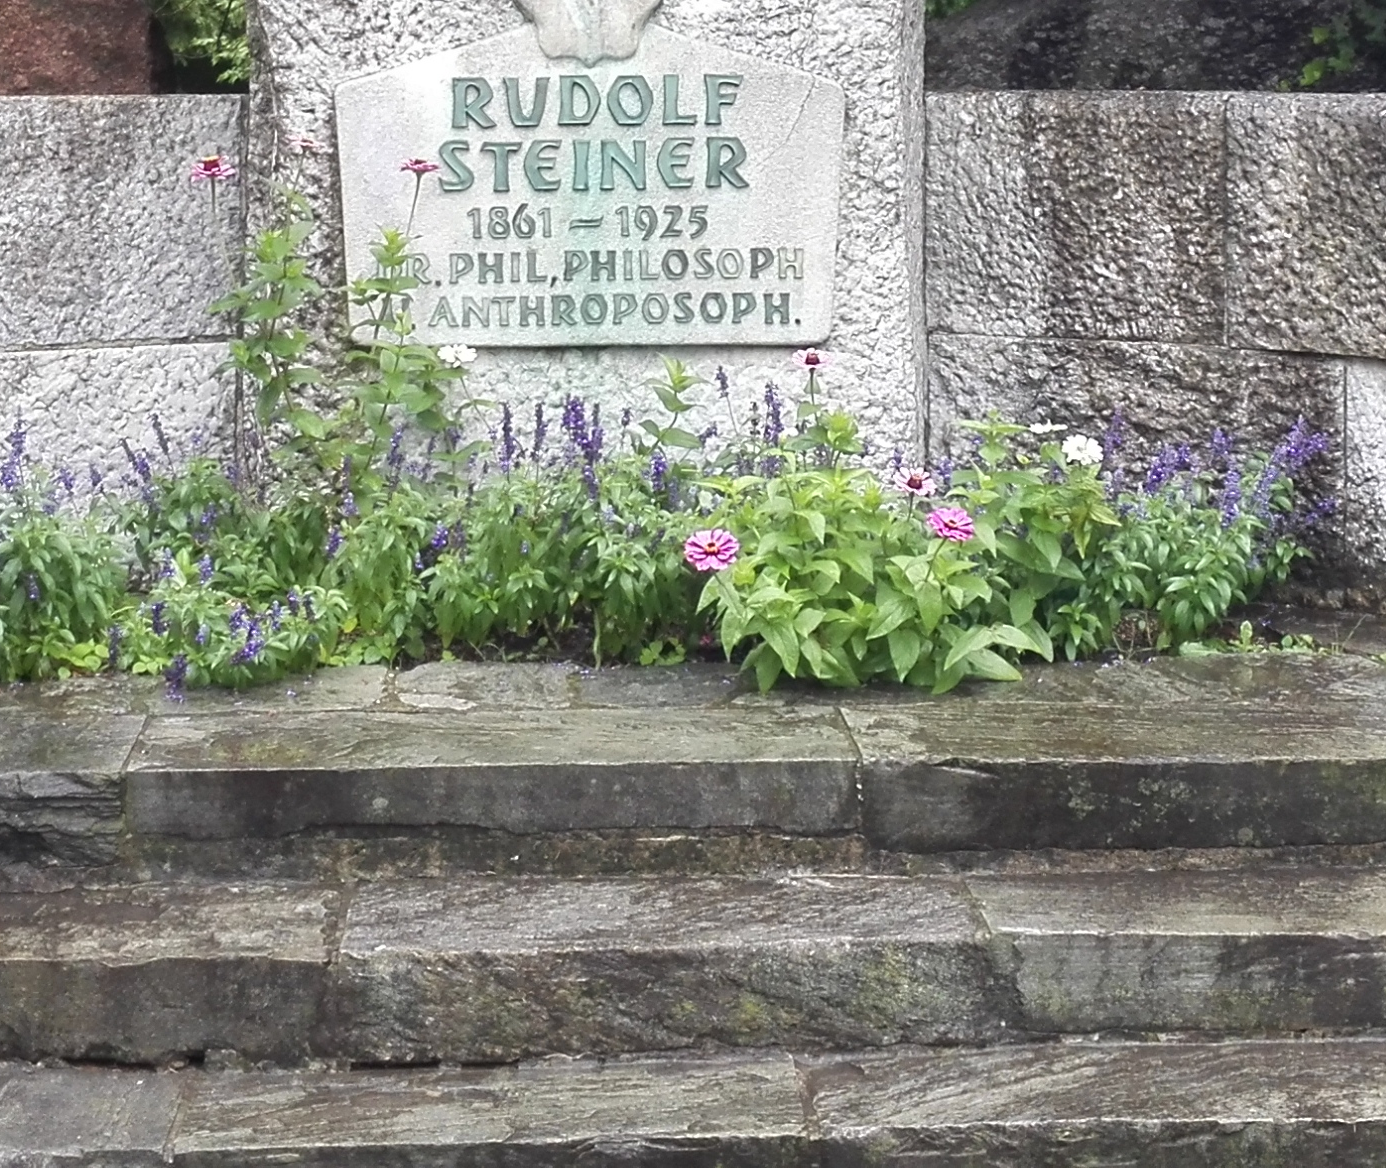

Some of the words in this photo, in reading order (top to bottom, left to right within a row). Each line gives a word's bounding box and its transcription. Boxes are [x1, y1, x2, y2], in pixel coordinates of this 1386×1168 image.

[451, 73, 744, 129] RUDOLF
[438, 136, 750, 192] STEINER
[466, 203, 553, 240] 1861
[614, 204, 709, 241] 1925
[428, 292, 801, 327] ANTHROPOSOPH.
